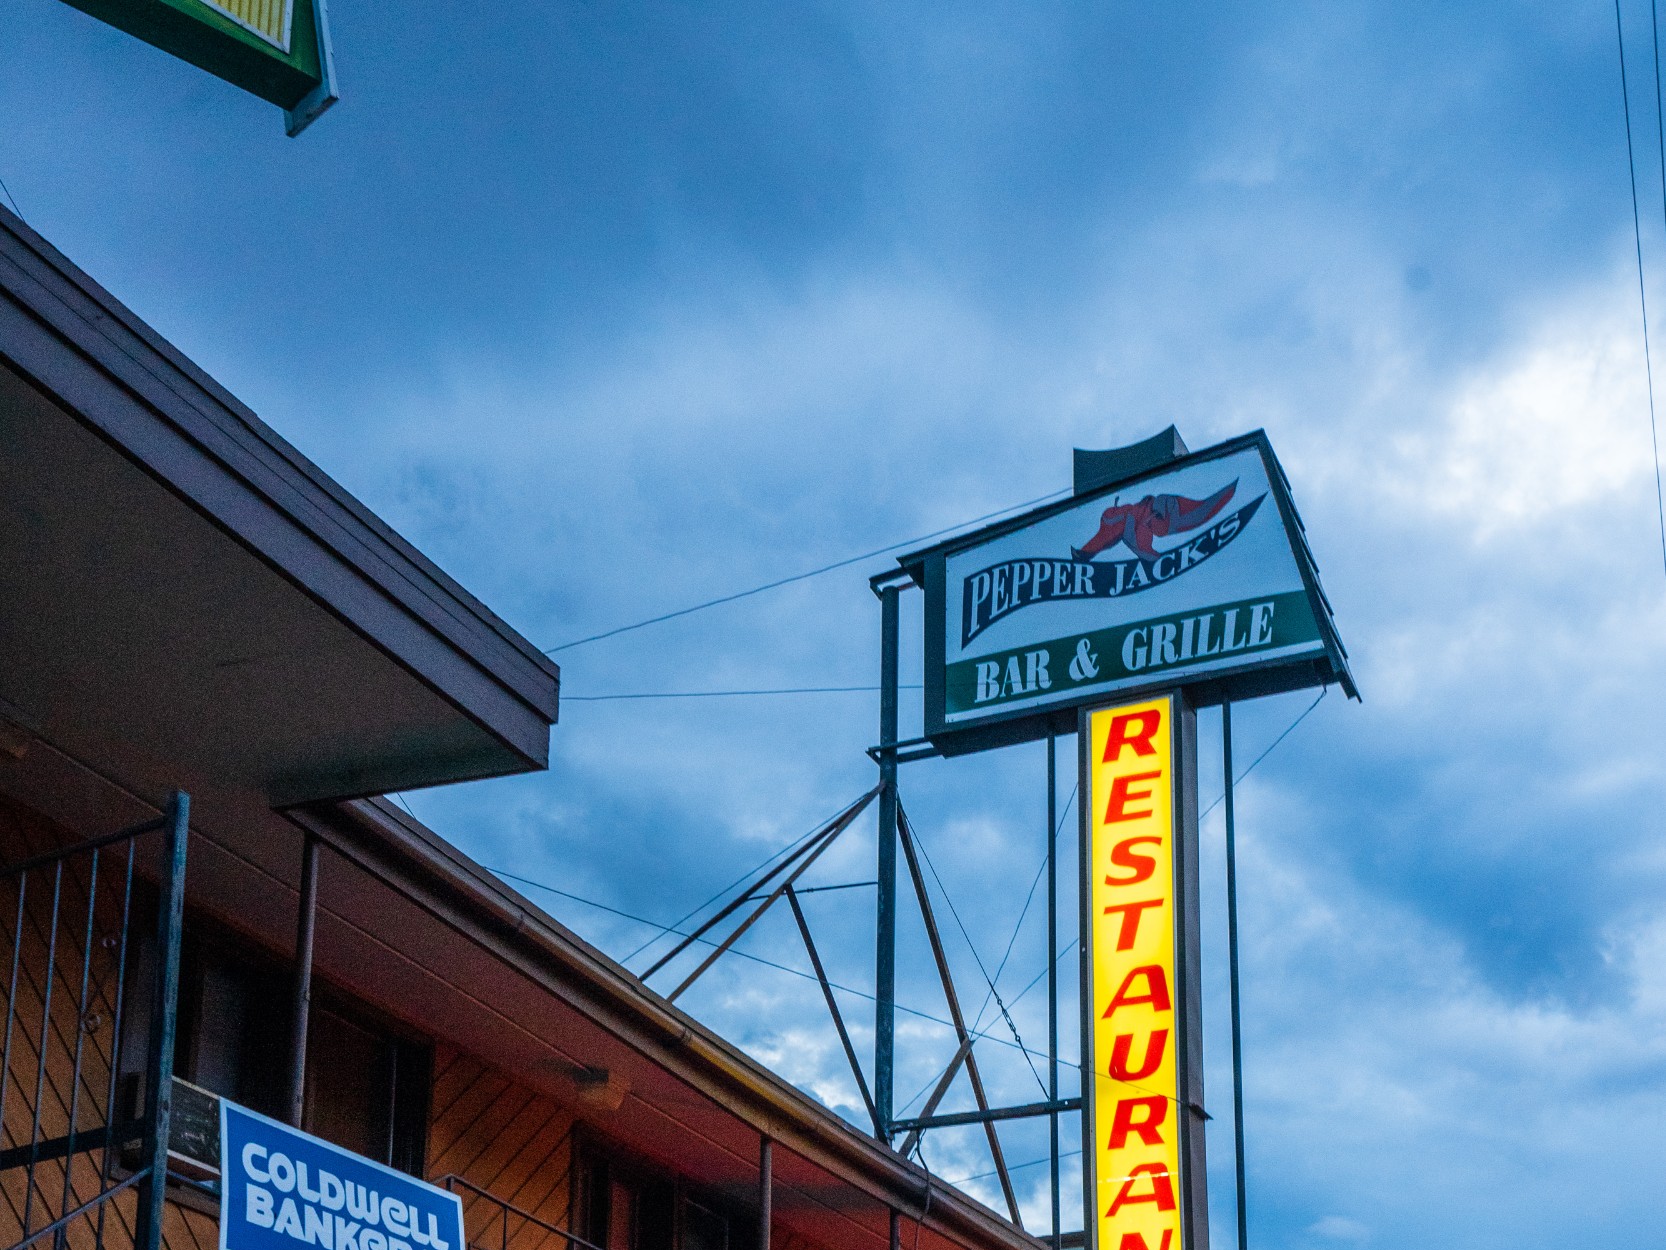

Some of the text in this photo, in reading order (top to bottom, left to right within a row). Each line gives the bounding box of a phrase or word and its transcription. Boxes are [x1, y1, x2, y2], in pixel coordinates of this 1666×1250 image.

[968, 512, 1242, 637] PEPPER JACK'S
[974, 602, 1275, 703] BAR & GRILLE
